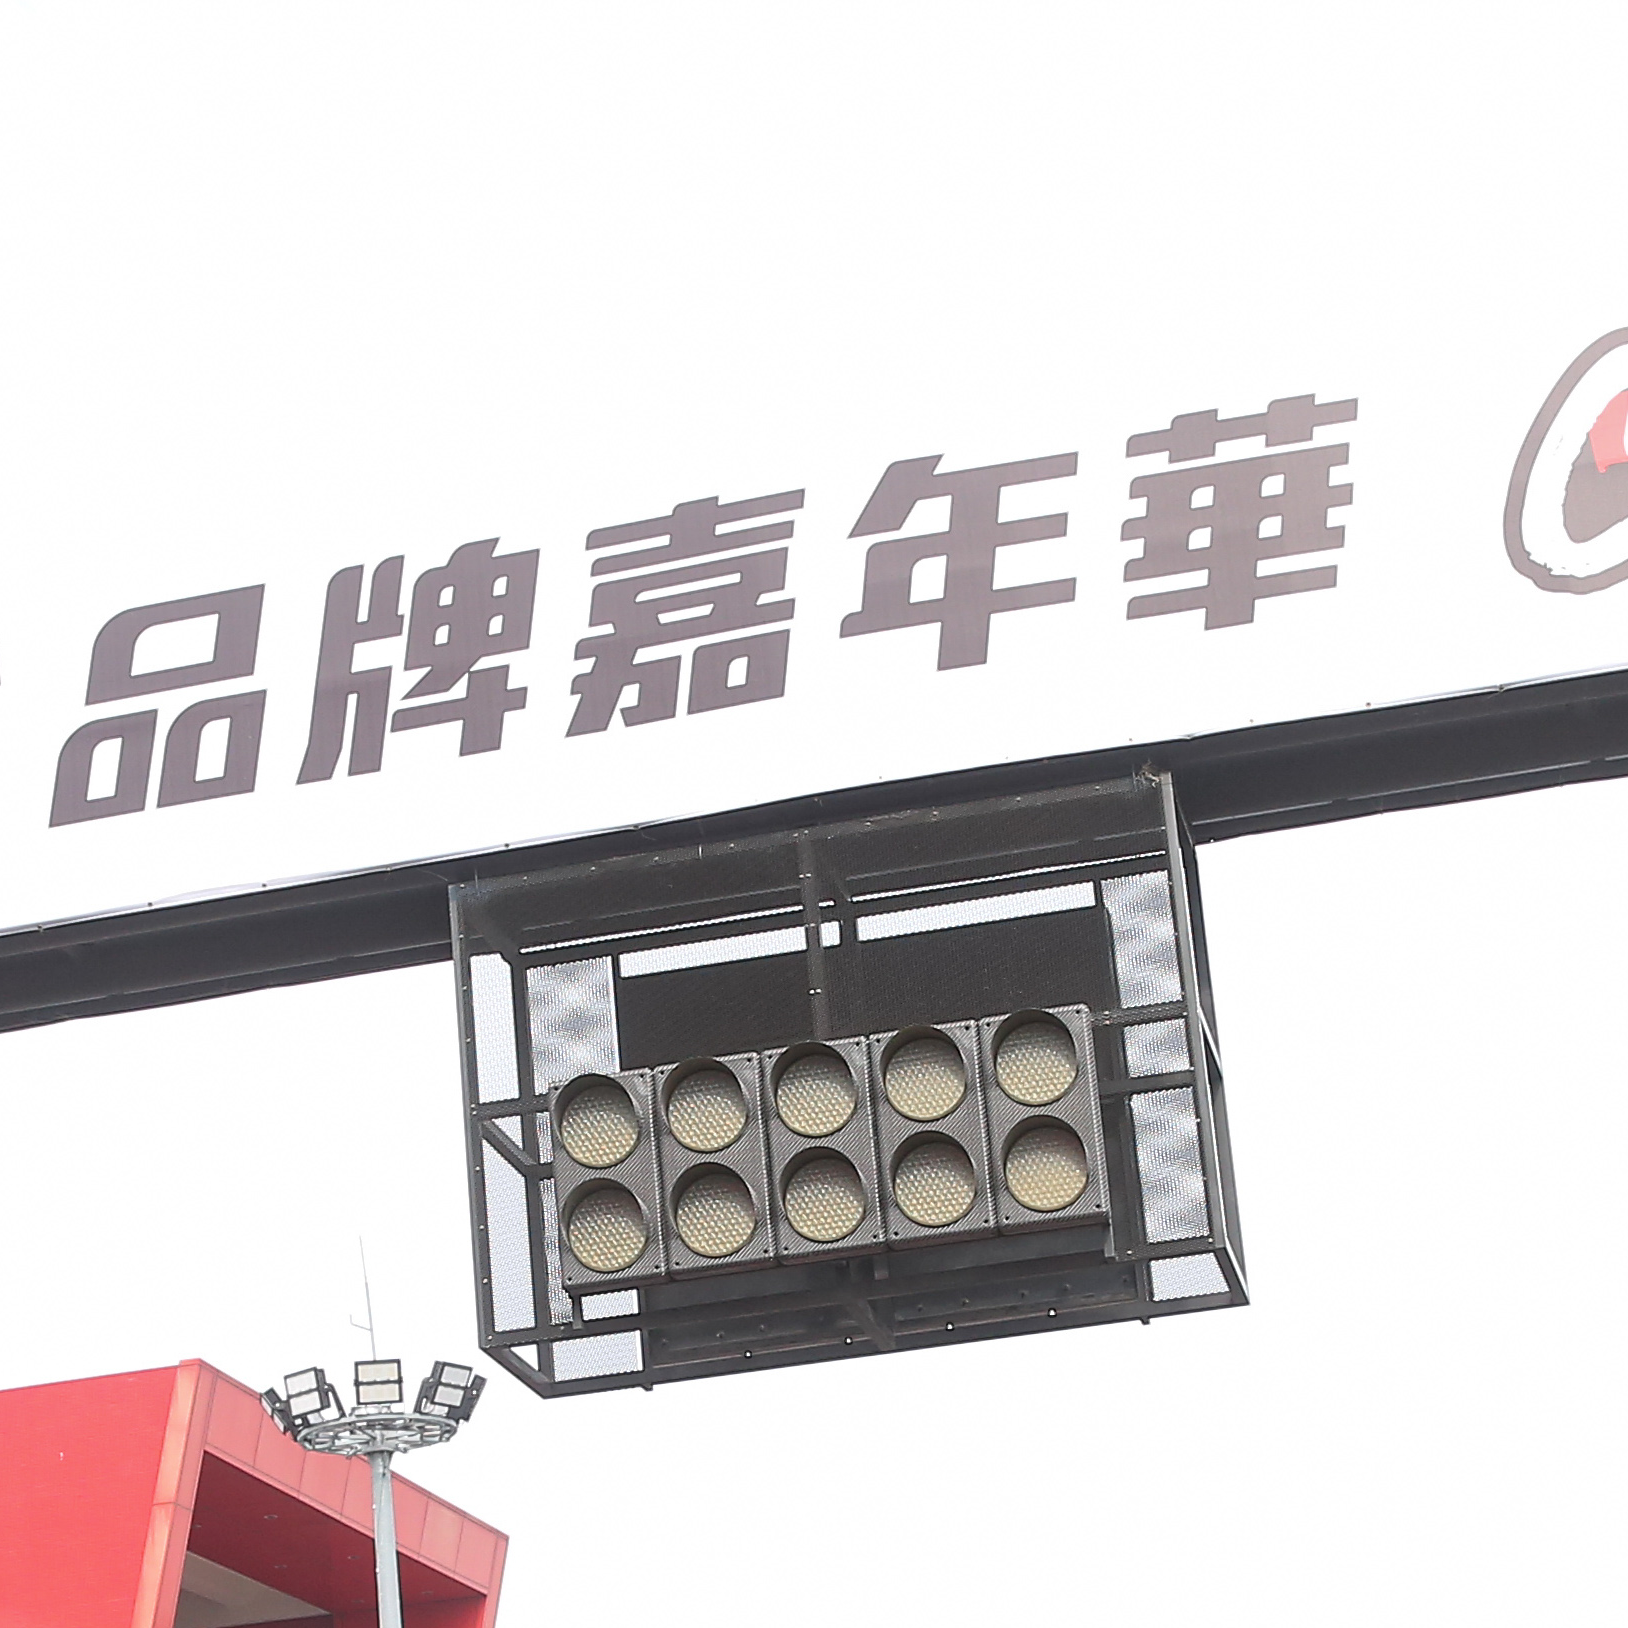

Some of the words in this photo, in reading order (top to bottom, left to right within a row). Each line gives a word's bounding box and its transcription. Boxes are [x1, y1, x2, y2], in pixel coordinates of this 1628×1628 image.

[48, 393, 1359, 829] 品牌嘉年華
